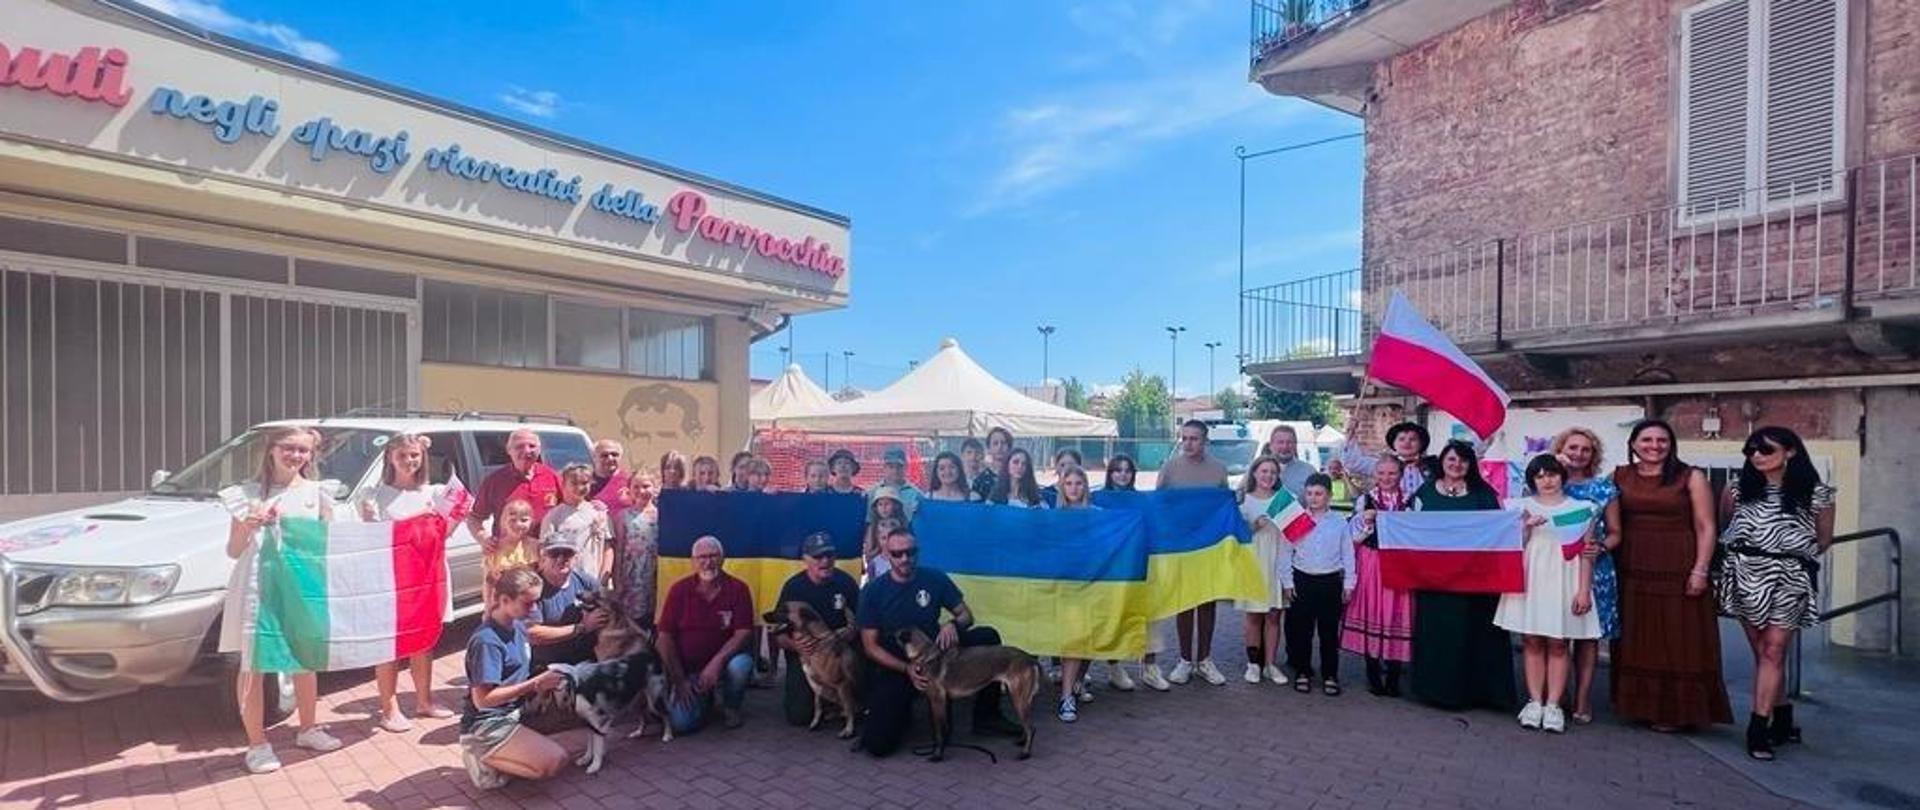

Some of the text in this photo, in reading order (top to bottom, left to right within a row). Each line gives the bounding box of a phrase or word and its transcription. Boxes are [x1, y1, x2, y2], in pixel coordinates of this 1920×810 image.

[150, 86, 281, 143] negli
[293, 118, 411, 173] spazi
[424, 144, 582, 204] ricreativi
[591, 184, 661, 224] della
[668, 190, 845, 277] Parrocchia
